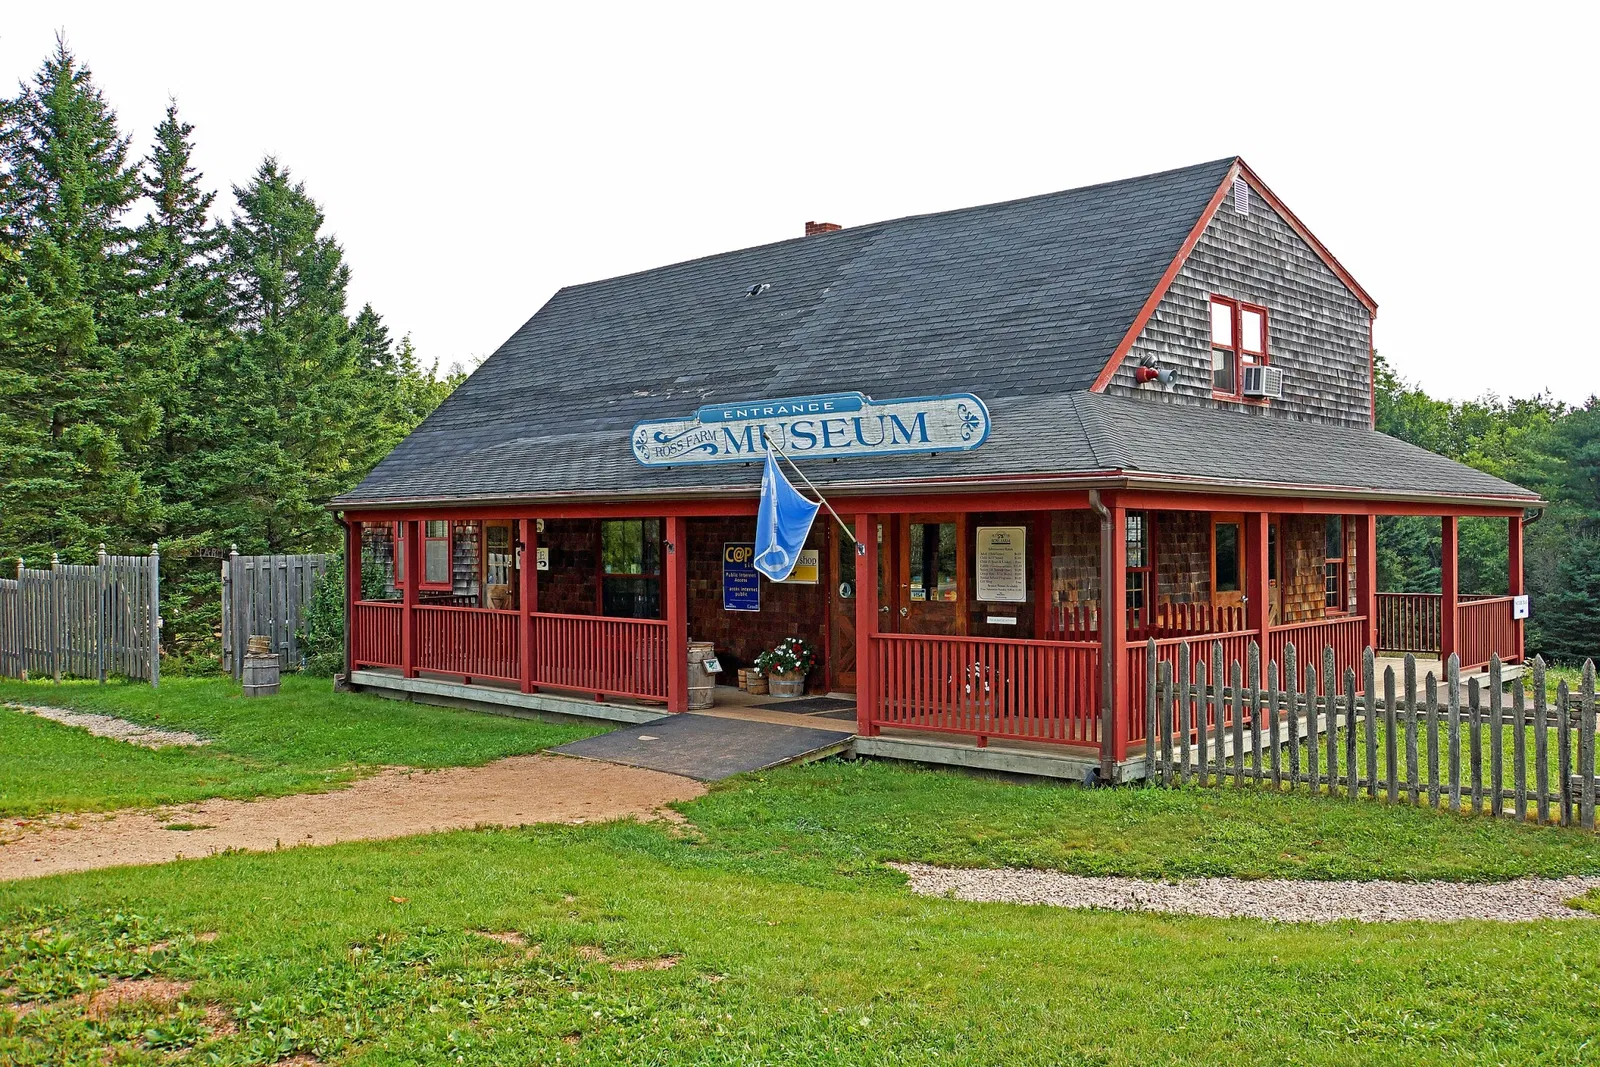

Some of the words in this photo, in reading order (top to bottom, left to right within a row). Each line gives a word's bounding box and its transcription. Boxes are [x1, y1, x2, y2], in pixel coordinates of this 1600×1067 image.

[723, 401, 835, 419] ENTRANCE
[721, 411, 932, 455] MUSEUM
[654, 442, 684, 458] ROSS
[686, 429, 718, 447] FARM
[725, 546, 752, 562] C@P
[800, 556, 816, 565] shop
